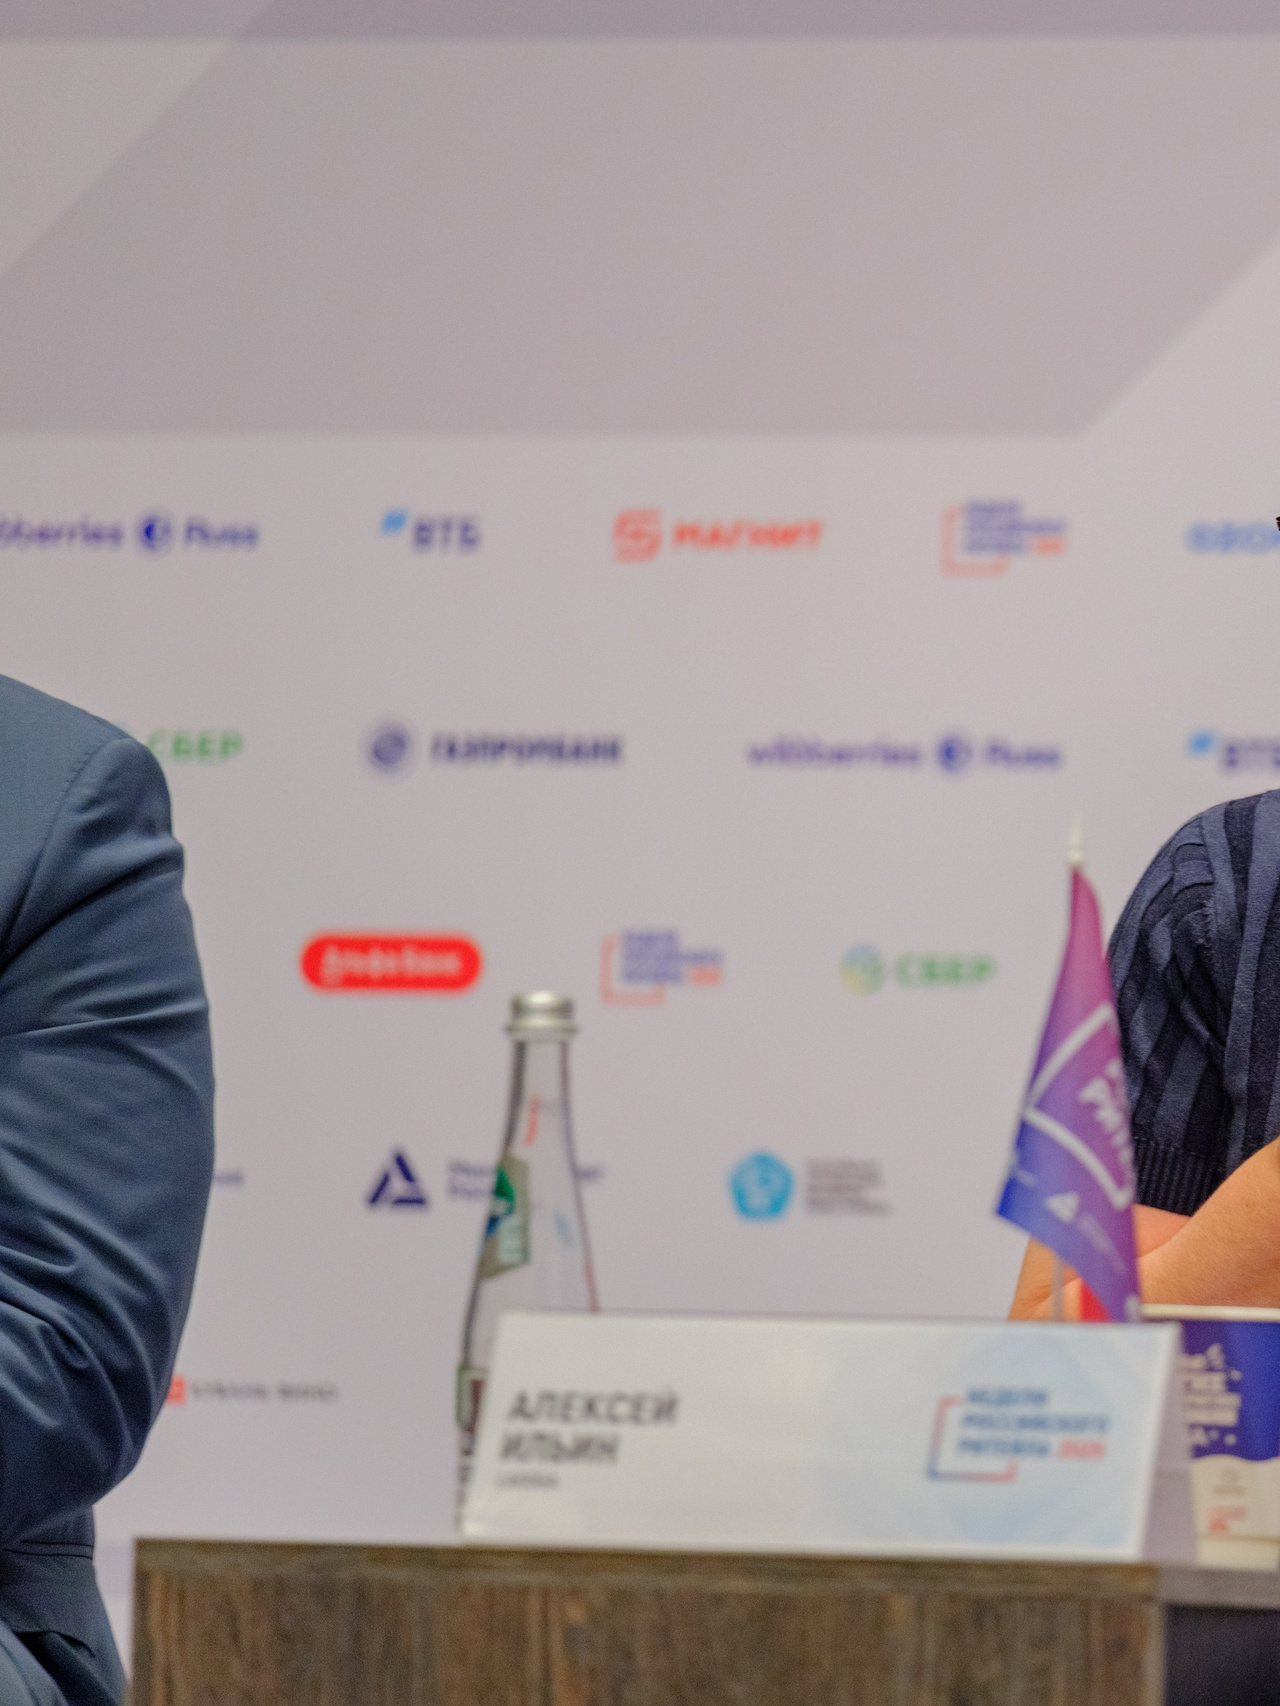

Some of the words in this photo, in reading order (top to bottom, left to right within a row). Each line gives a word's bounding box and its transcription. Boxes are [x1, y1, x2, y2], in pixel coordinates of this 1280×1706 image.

[672, 520, 823, 549] МАГНИТ
[897, 954, 996, 987] СБЕР
[506, 1387, 681, 1427] АЛЕКСЕЙ
[500, 1430, 621, 1465] ИЛЬИН
